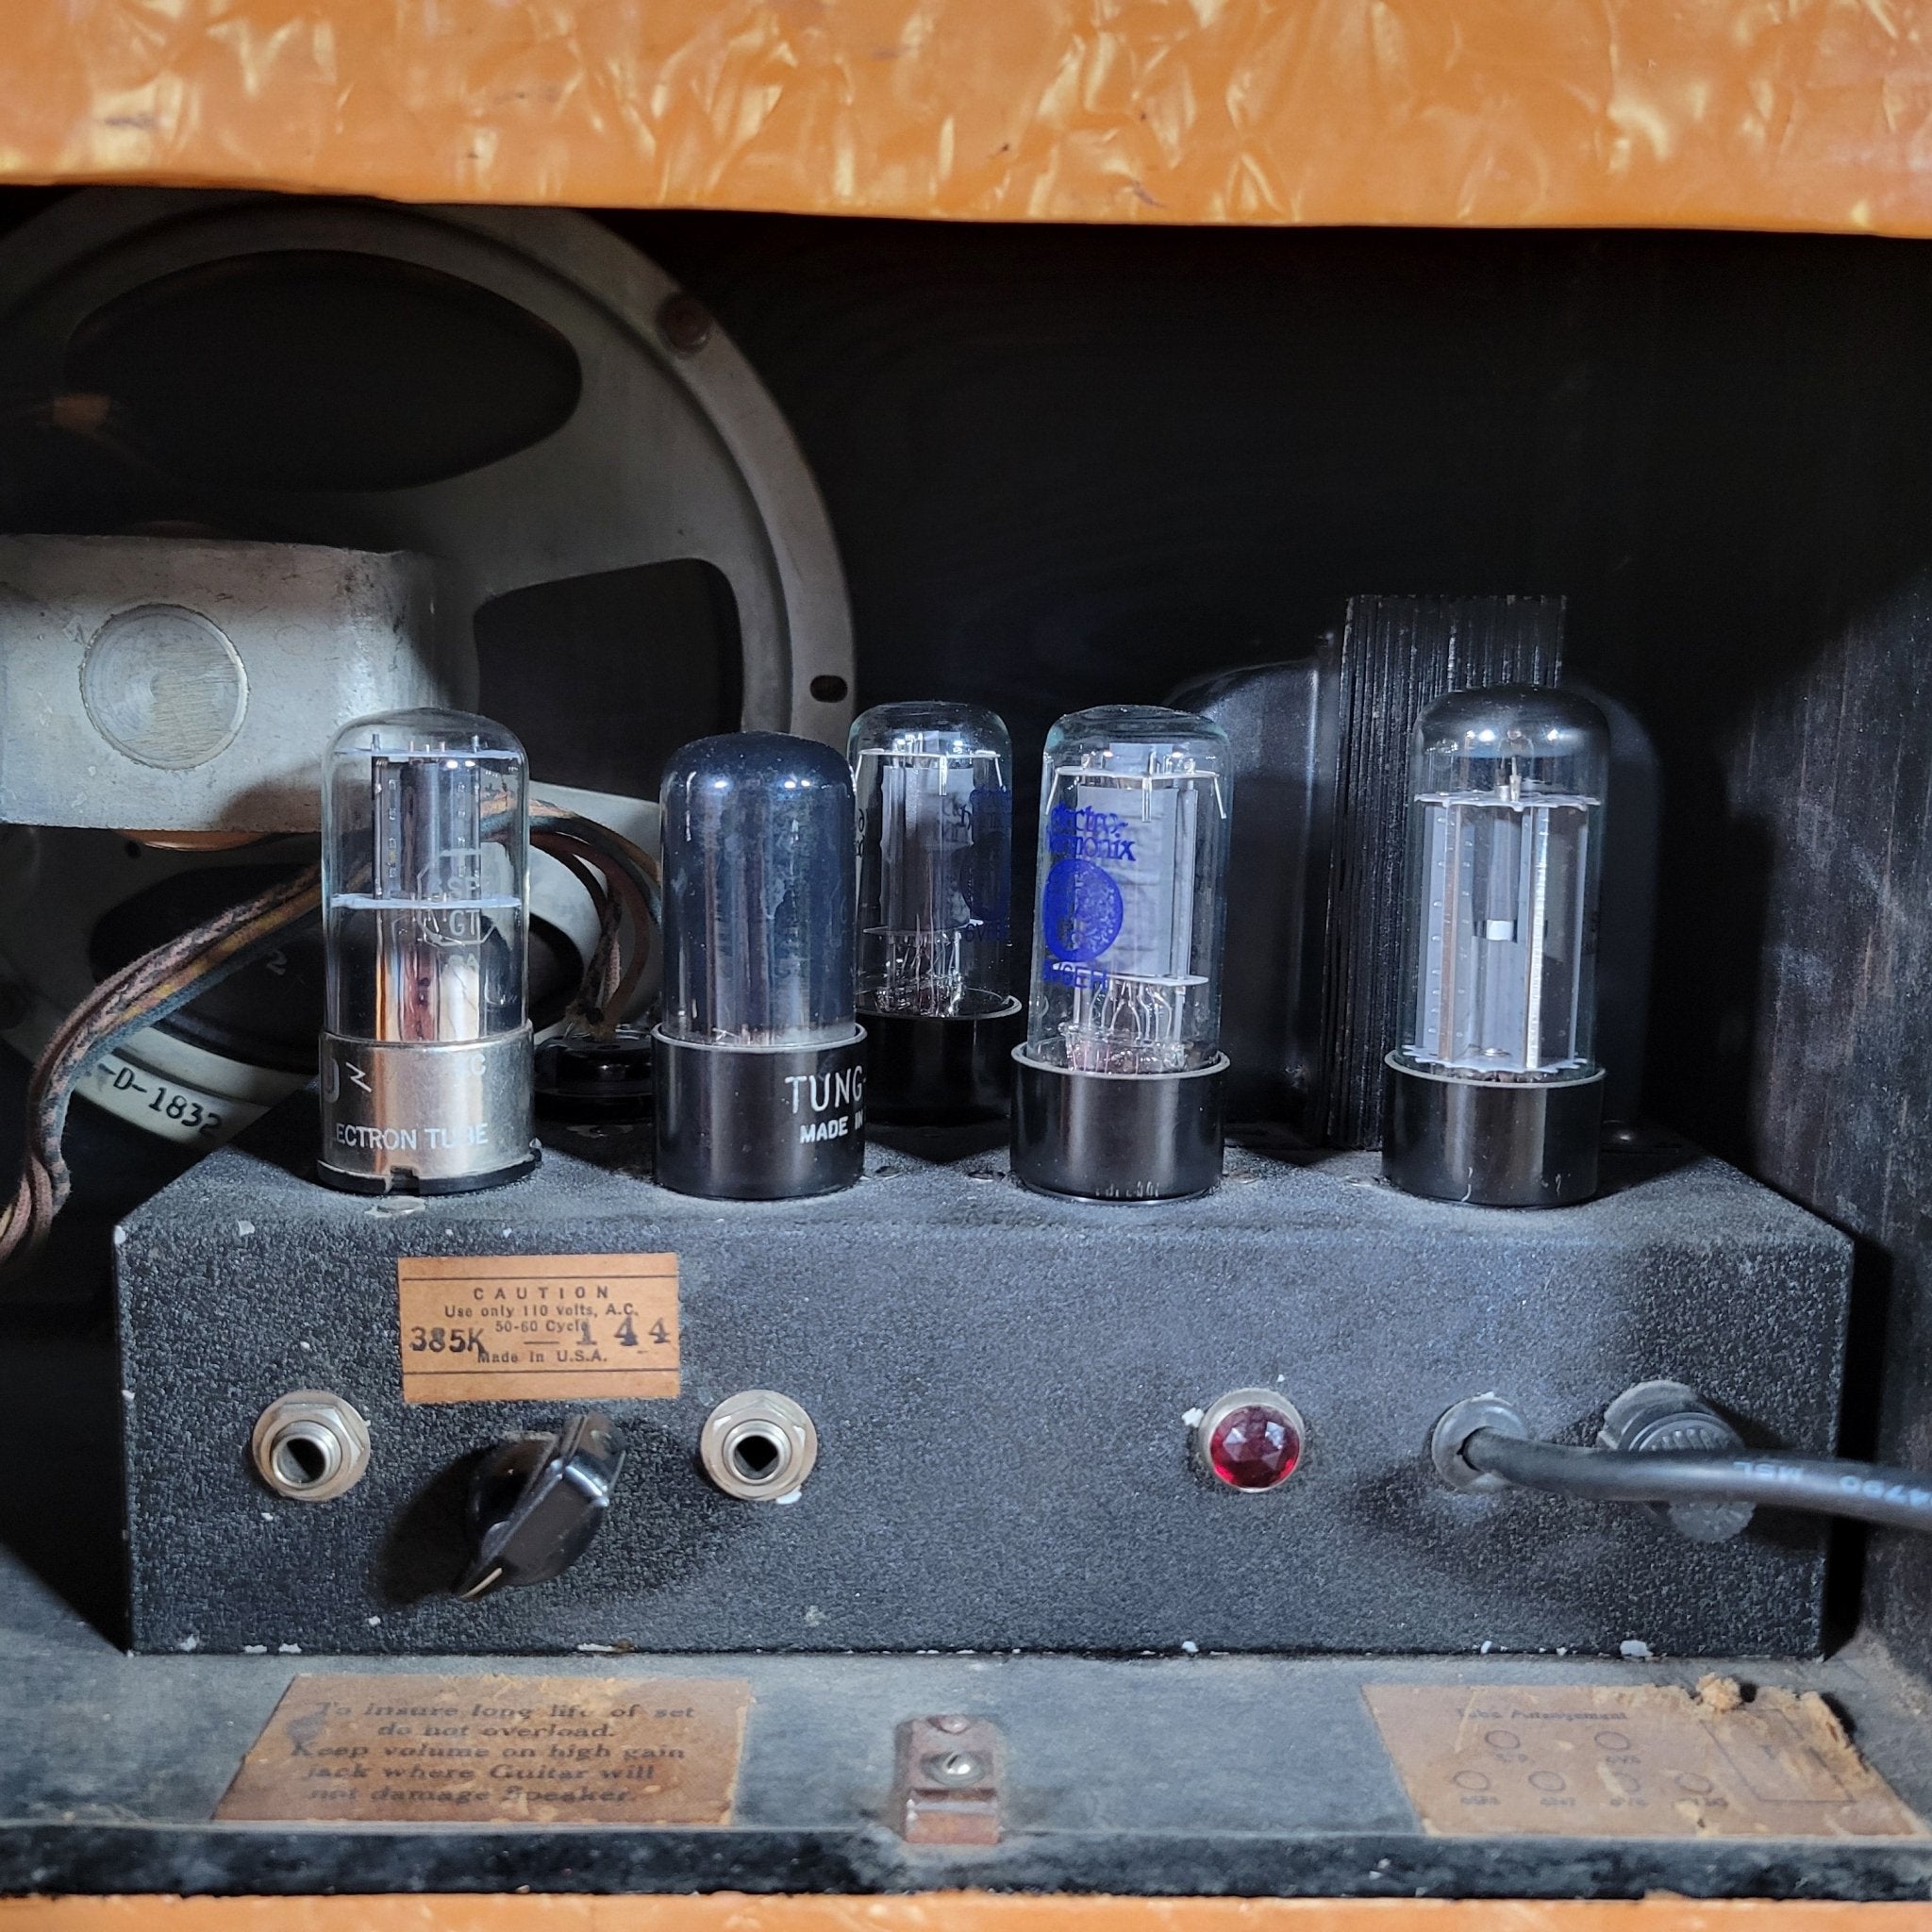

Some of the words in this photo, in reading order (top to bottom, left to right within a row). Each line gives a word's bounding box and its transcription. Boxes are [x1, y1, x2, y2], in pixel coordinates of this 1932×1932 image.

[449, 909, 480, 936] GT
[800, 1115, 849, 1143] MADE
[474, 1286, 609, 1301] CAUTION
[444, 1305, 472, 1318] Use
[481, 1305, 514, 1318] only
[523, 1304, 548, 1317] 110
[605, 1303, 640, 1317] A.C.
[495, 1320, 538, 1334] 50-60
[408, 1325, 485, 1355] 385K
[477, 1351, 519, 1363] Made
[557, 1349, 608, 1362] U.S.A.
[364, 1703, 459, 1717] insure
[472, 1704, 534, 1720] long
[611, 1704, 641, 1718] of
[654, 1707, 696, 1719] set
[377, 1723, 412, 1737] do
[424, 1724, 471, 1738] not
[481, 1724, 615, 1738] overload.
[291, 1740, 369, 1759] Keep
[383, 1743, 491, 1757] volume
[502, 1747, 537, 1758] on
[548, 1744, 611, 1762] high
[624, 1745, 686, 1761] gain
[383, 1764, 475, 1779] where
[489, 1764, 590, 1780] Guitar
[601, 1765, 656, 1780] will
